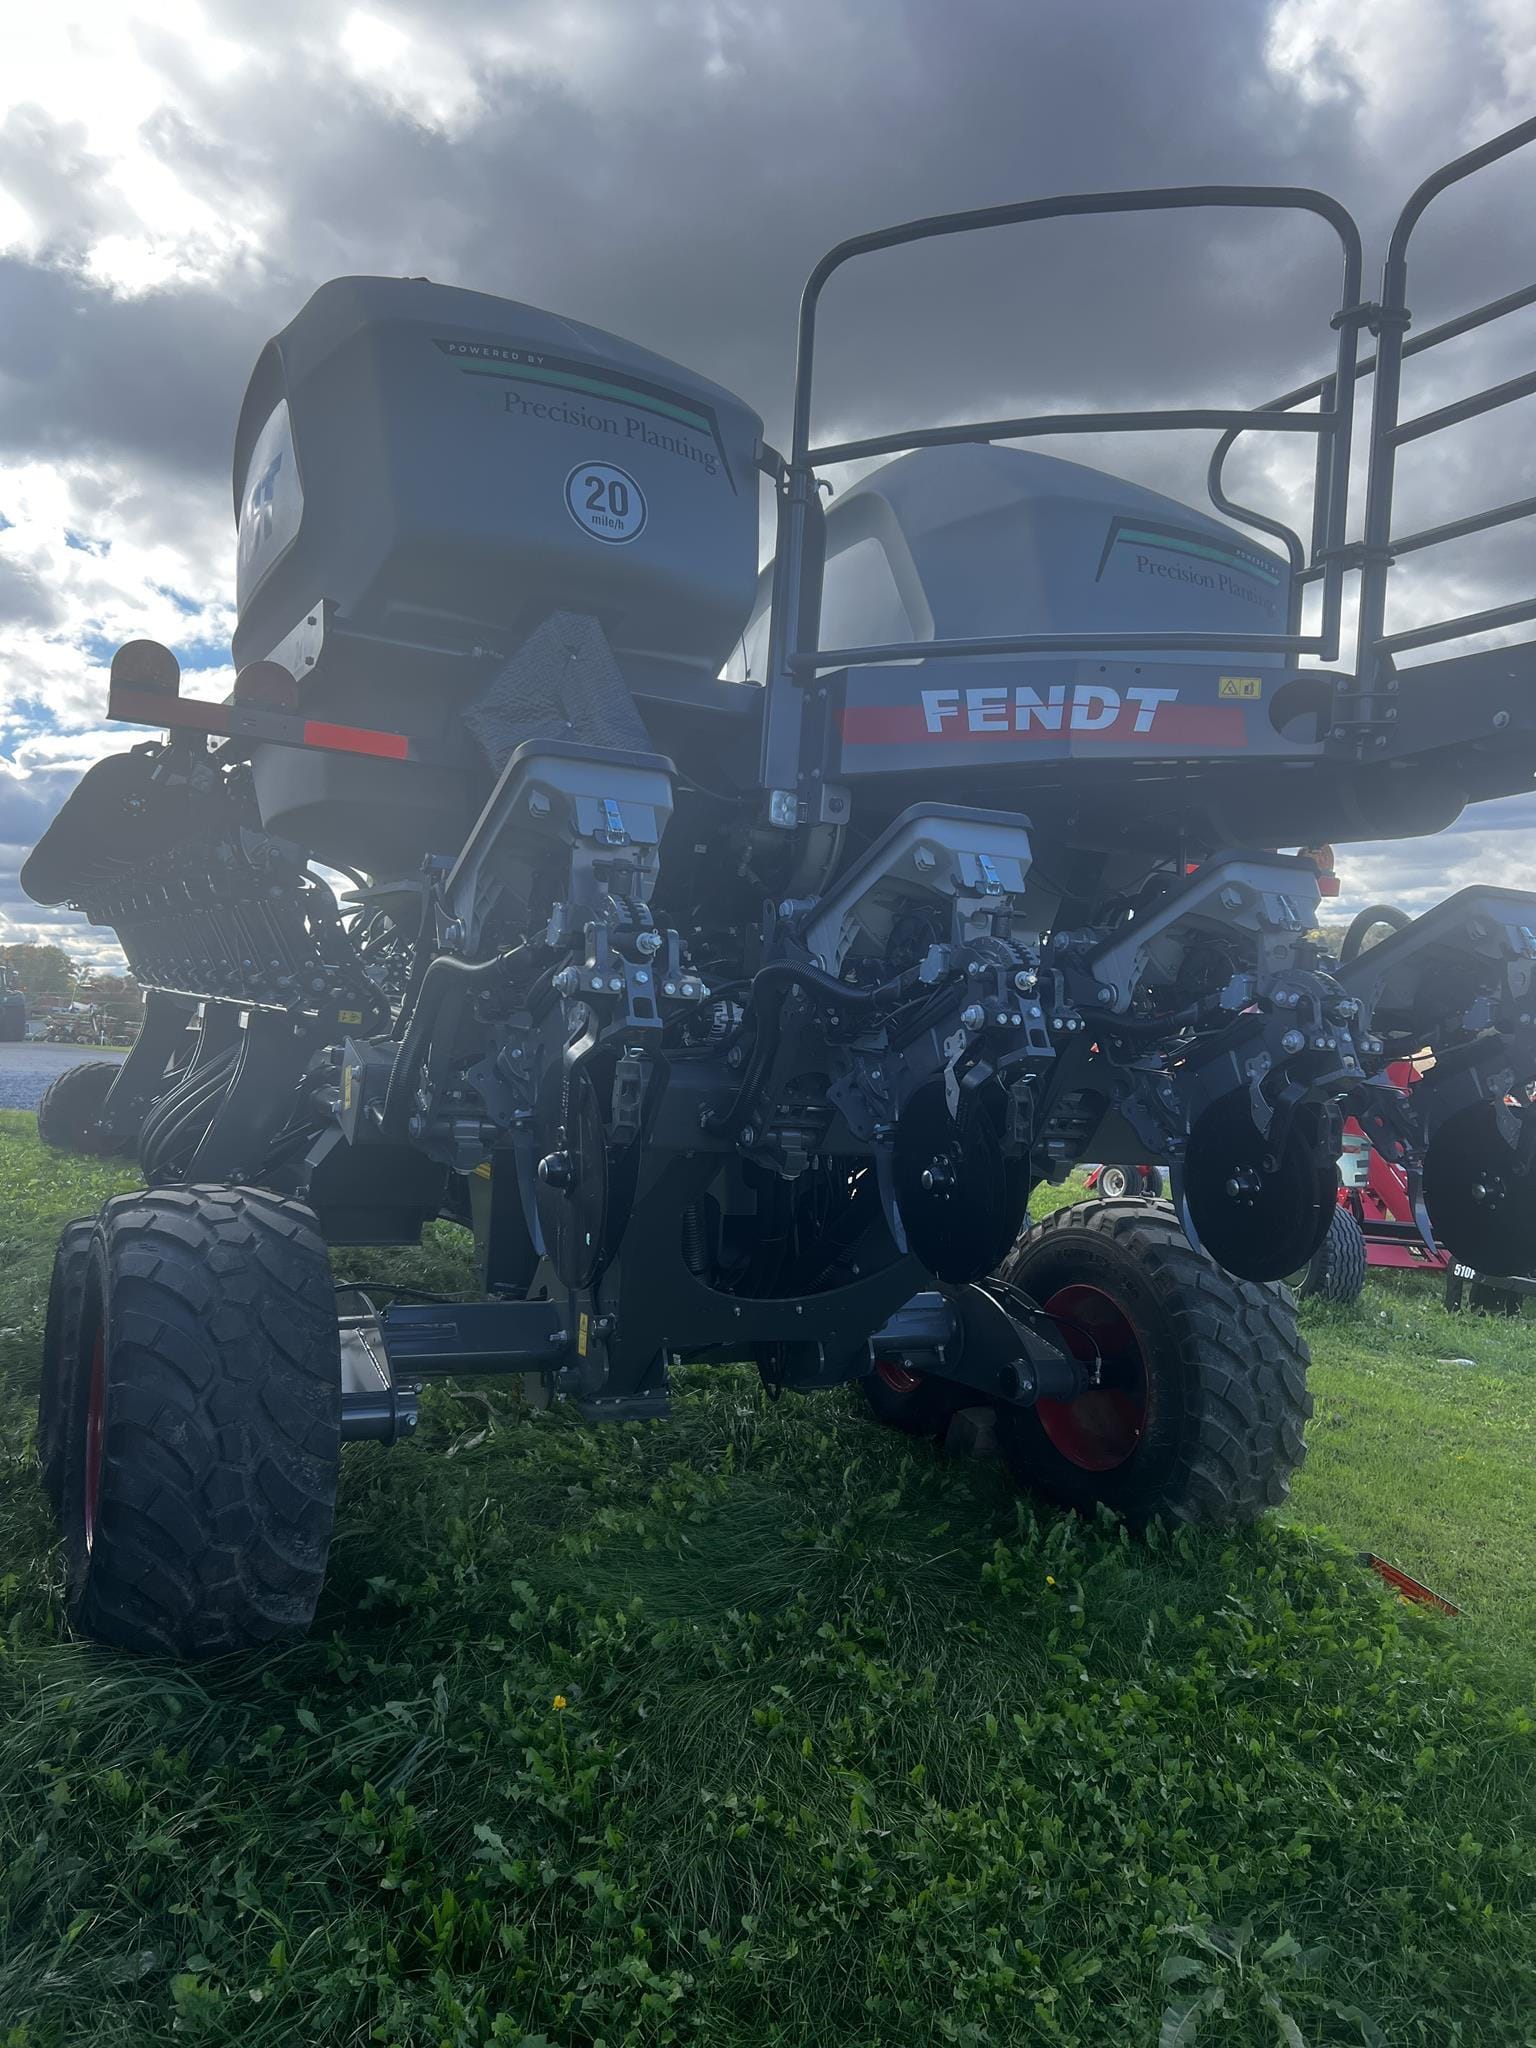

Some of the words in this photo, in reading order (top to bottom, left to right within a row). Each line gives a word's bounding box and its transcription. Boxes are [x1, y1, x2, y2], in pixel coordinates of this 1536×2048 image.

[449, 344, 519, 360] POWERED
[528, 355, 544, 364] BY
[504, 391, 618, 435] Precision
[624, 416, 719, 476] Planting
[584, 475, 629, 517] 20
[591, 514, 625, 531] mile/h
[1136, 555, 1215, 589] Precision
[920, 685, 1179, 733] FENDT
